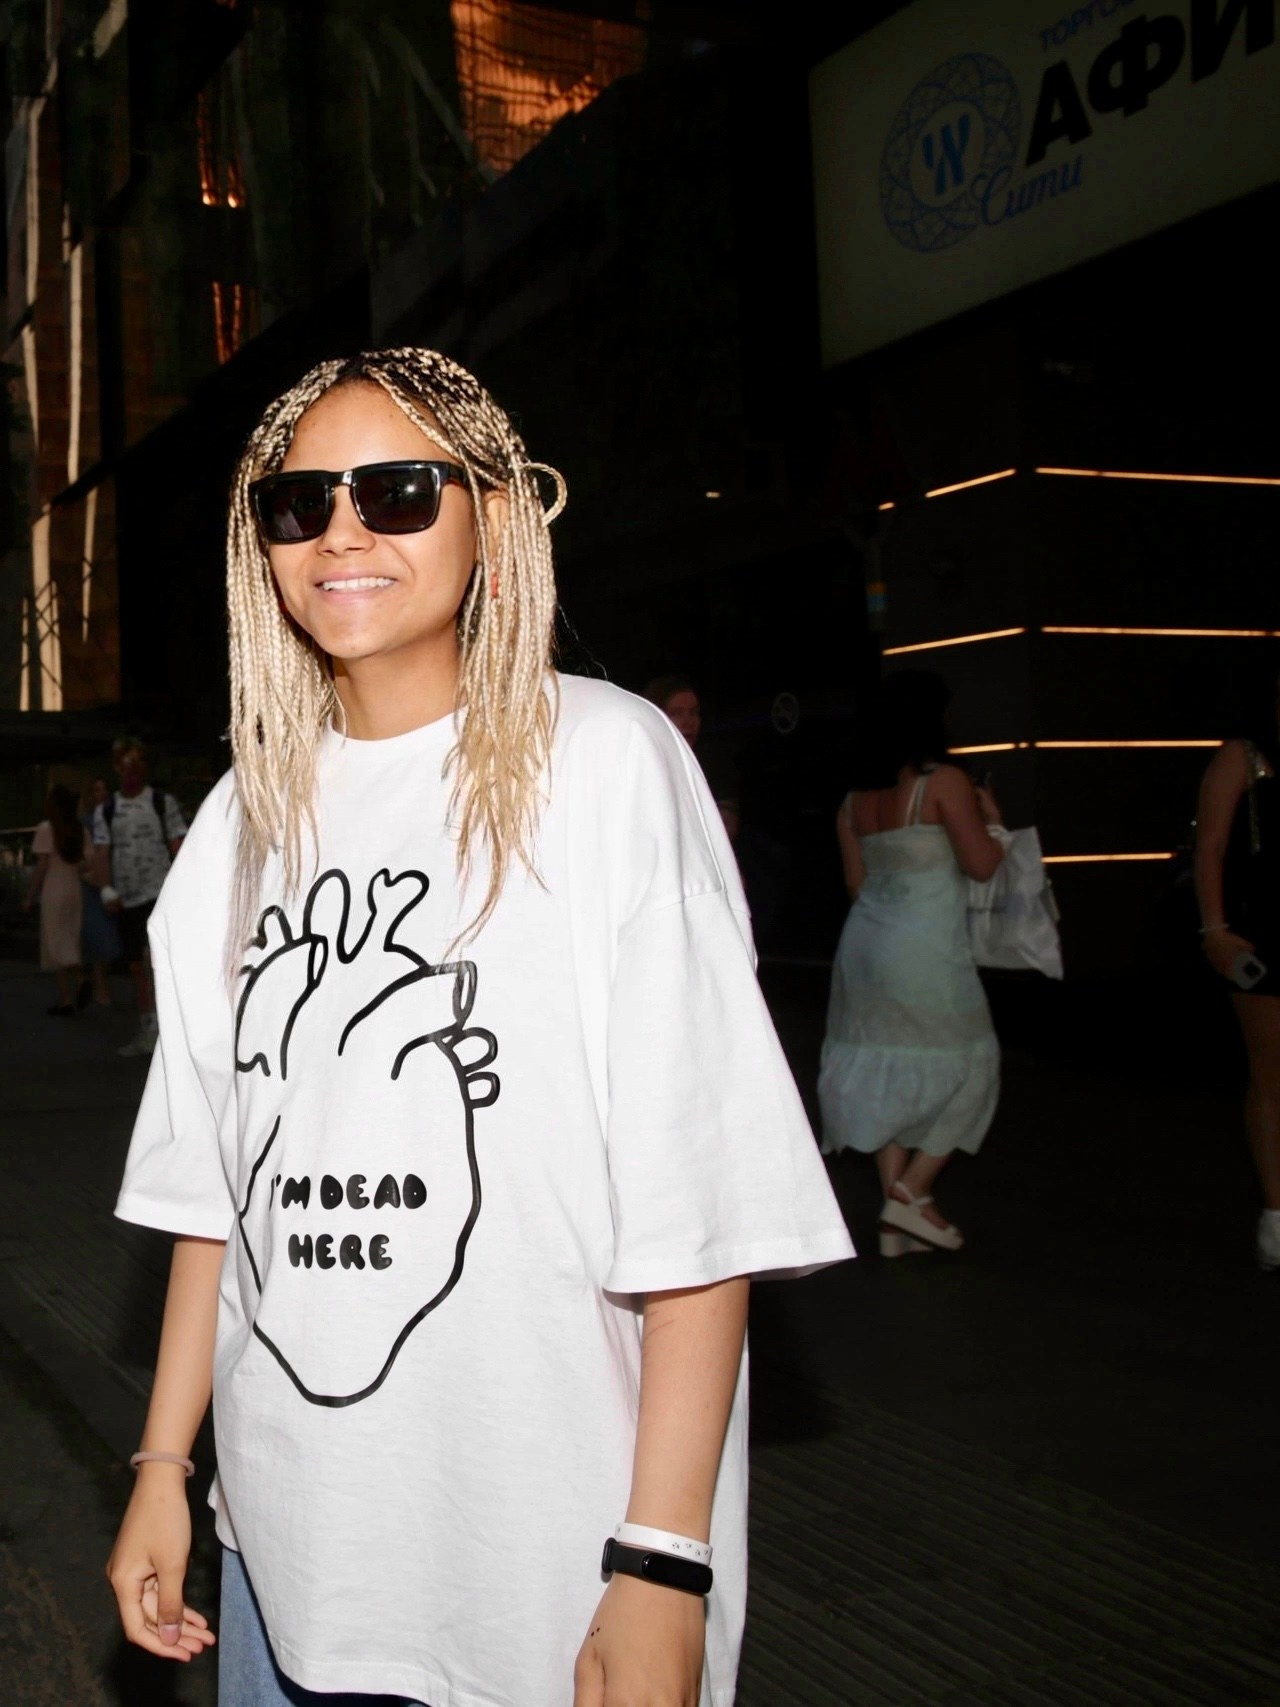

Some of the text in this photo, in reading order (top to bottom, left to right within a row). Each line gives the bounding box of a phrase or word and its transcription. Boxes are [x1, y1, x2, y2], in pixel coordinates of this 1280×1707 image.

[970, 153, 1083, 226] Сити
[319, 1173, 427, 1210] DEAD
[287, 1233, 393, 1271] HERE
